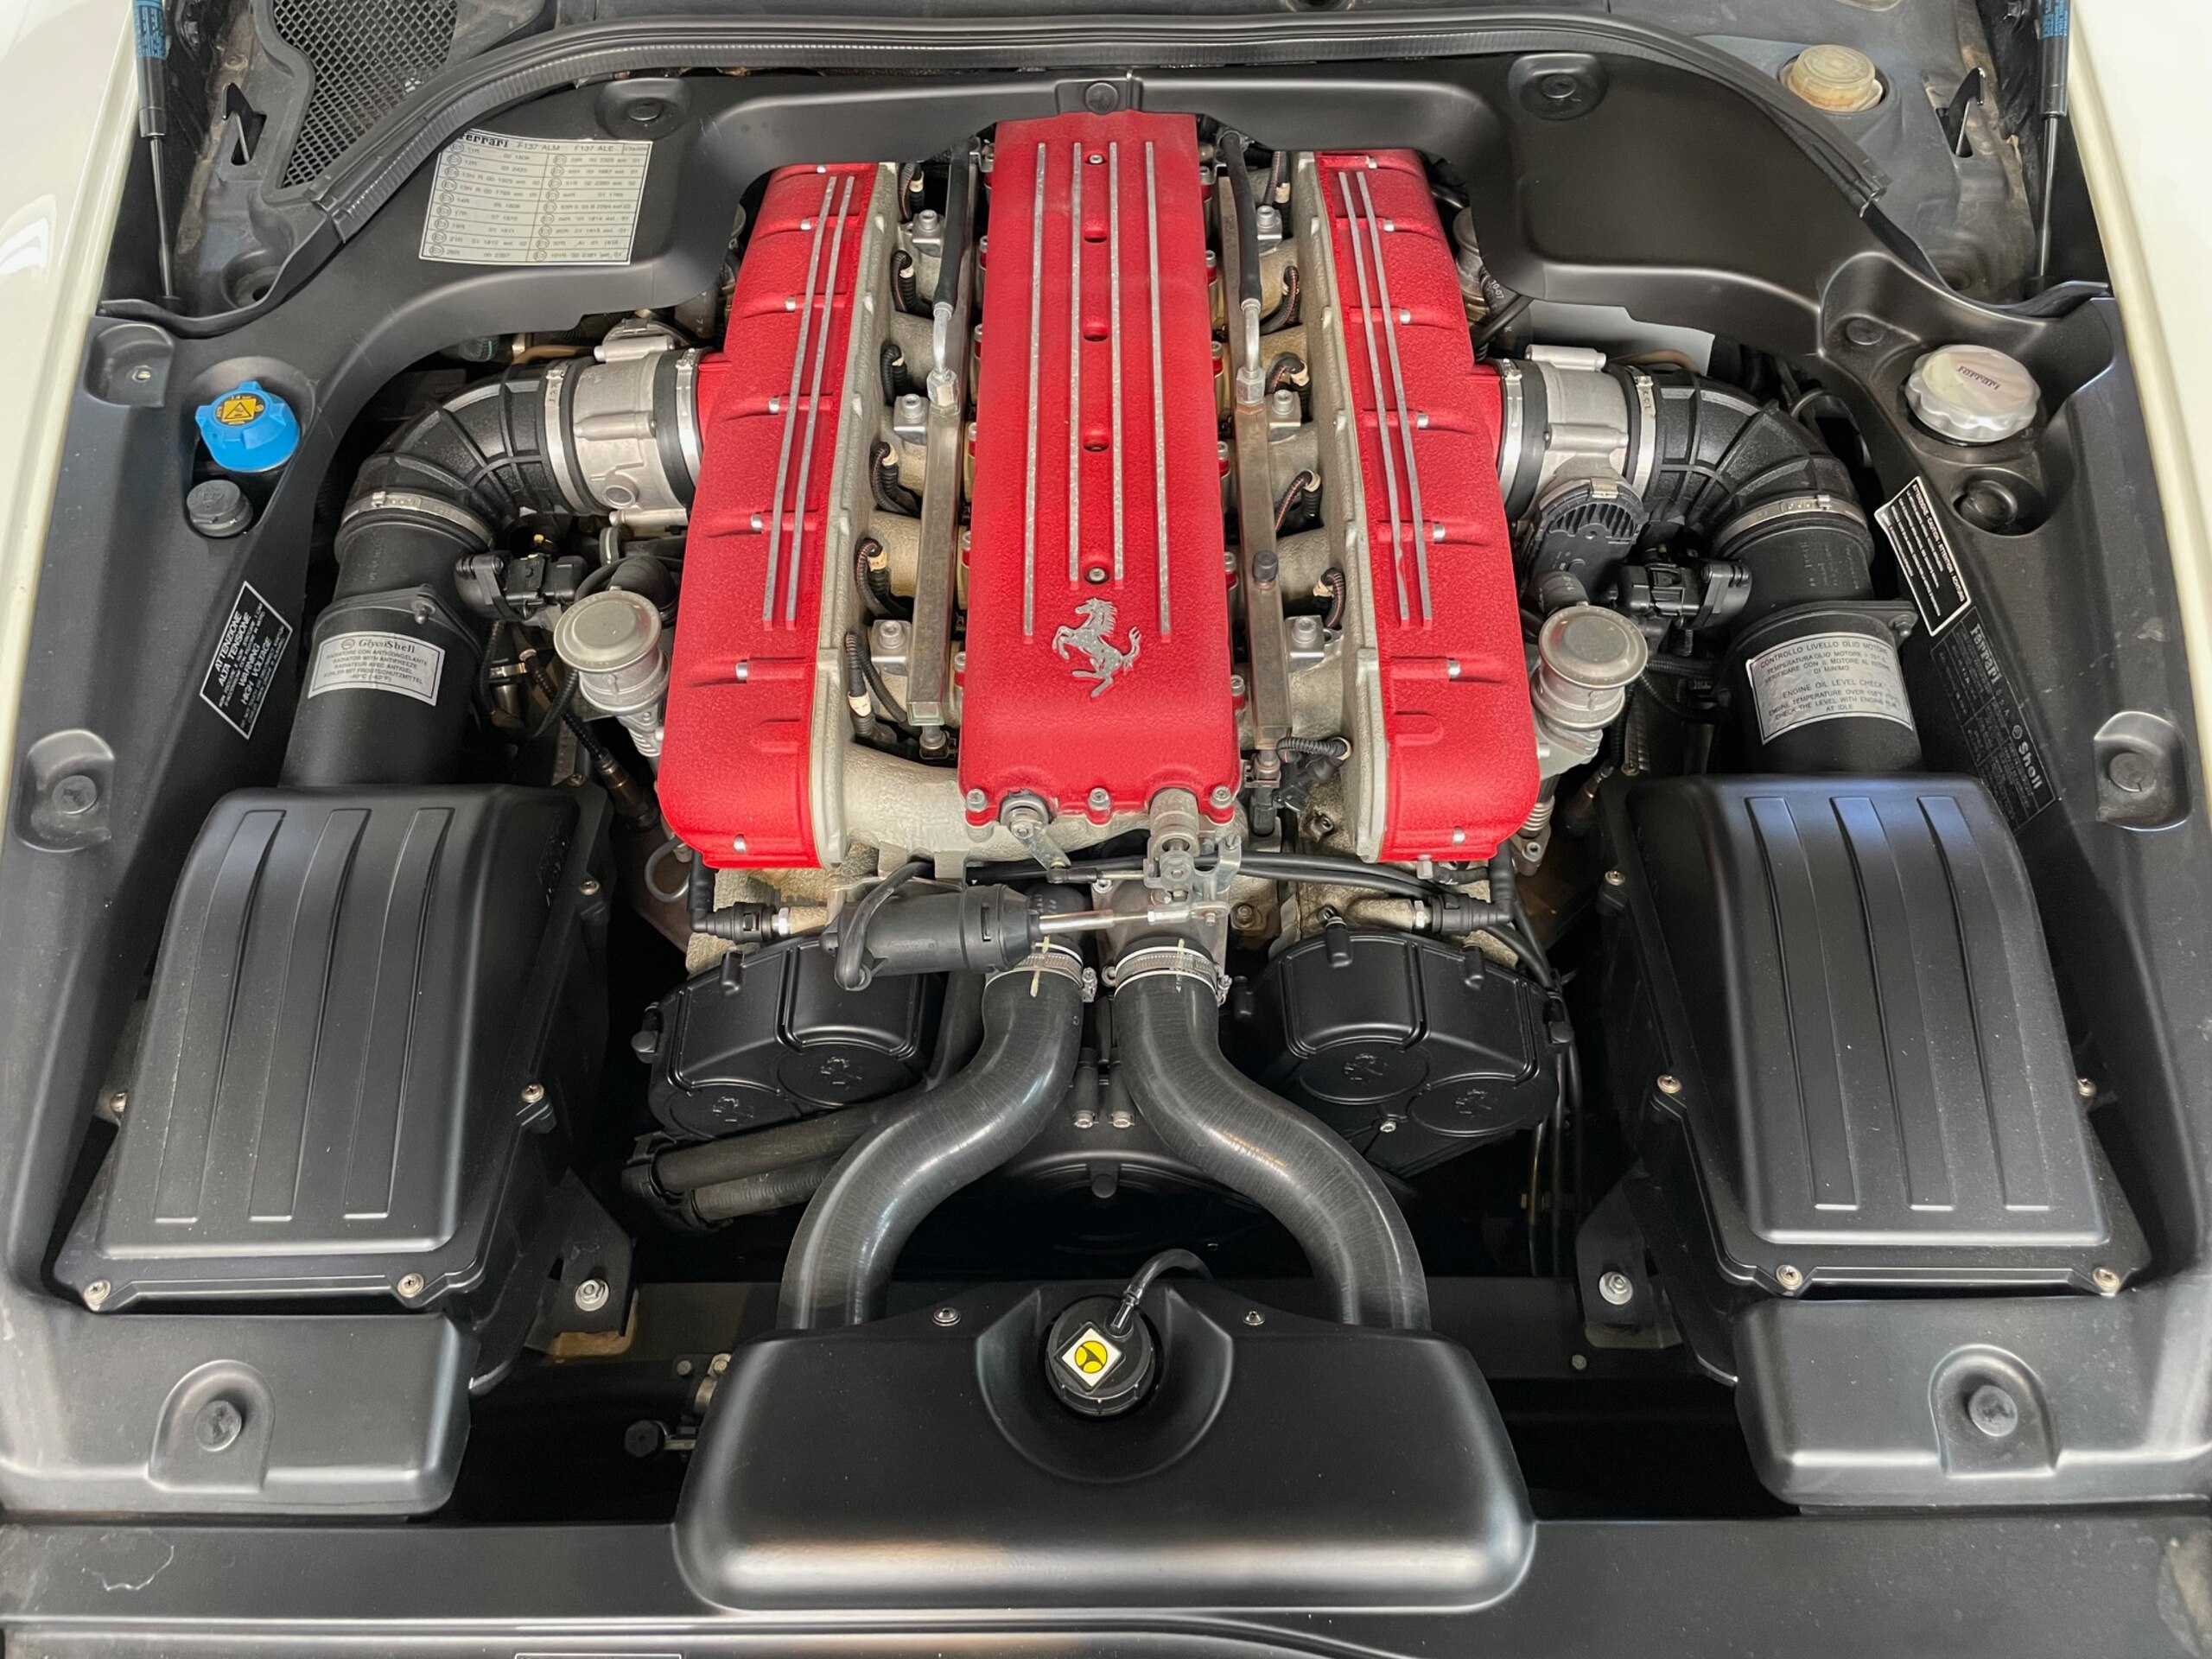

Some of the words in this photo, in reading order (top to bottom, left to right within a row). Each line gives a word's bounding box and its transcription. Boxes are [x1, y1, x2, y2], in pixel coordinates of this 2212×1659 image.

[215, 611, 241, 671] ATTENZIONE
[218, 663, 231, 686] ALTA
[227, 612, 251, 659] TENSIONE
[359, 639, 415, 653] GlycoShell
[372, 650, 428, 666] ANTICONGELANTE
[379, 657, 417, 668] ANTIFREEZE
[1761, 646, 1803, 669] CONTROLLO
[1807, 641, 1839, 652] LIVELLO
[1970, 624, 2001, 683] Ferrari
[238, 643, 260, 686] WARNING
[240, 680, 254, 704] HIGH
[251, 637, 271, 677] VOLTAGE
[386, 664, 413, 674] ANTIGEL
[1764, 665, 1800, 683] VERIFICARE
[1767, 655, 1814, 674] TEMPERATURA
[1783, 684, 1811, 698] ENGINE
[1831, 678, 1856, 687] LEVEL
[1859, 679, 1883, 688] CHECK
[1792, 690, 1841, 704] TEMPERATURE
[1776, 706, 1798, 720] CHECK
[2018, 741, 2042, 788] Shell
